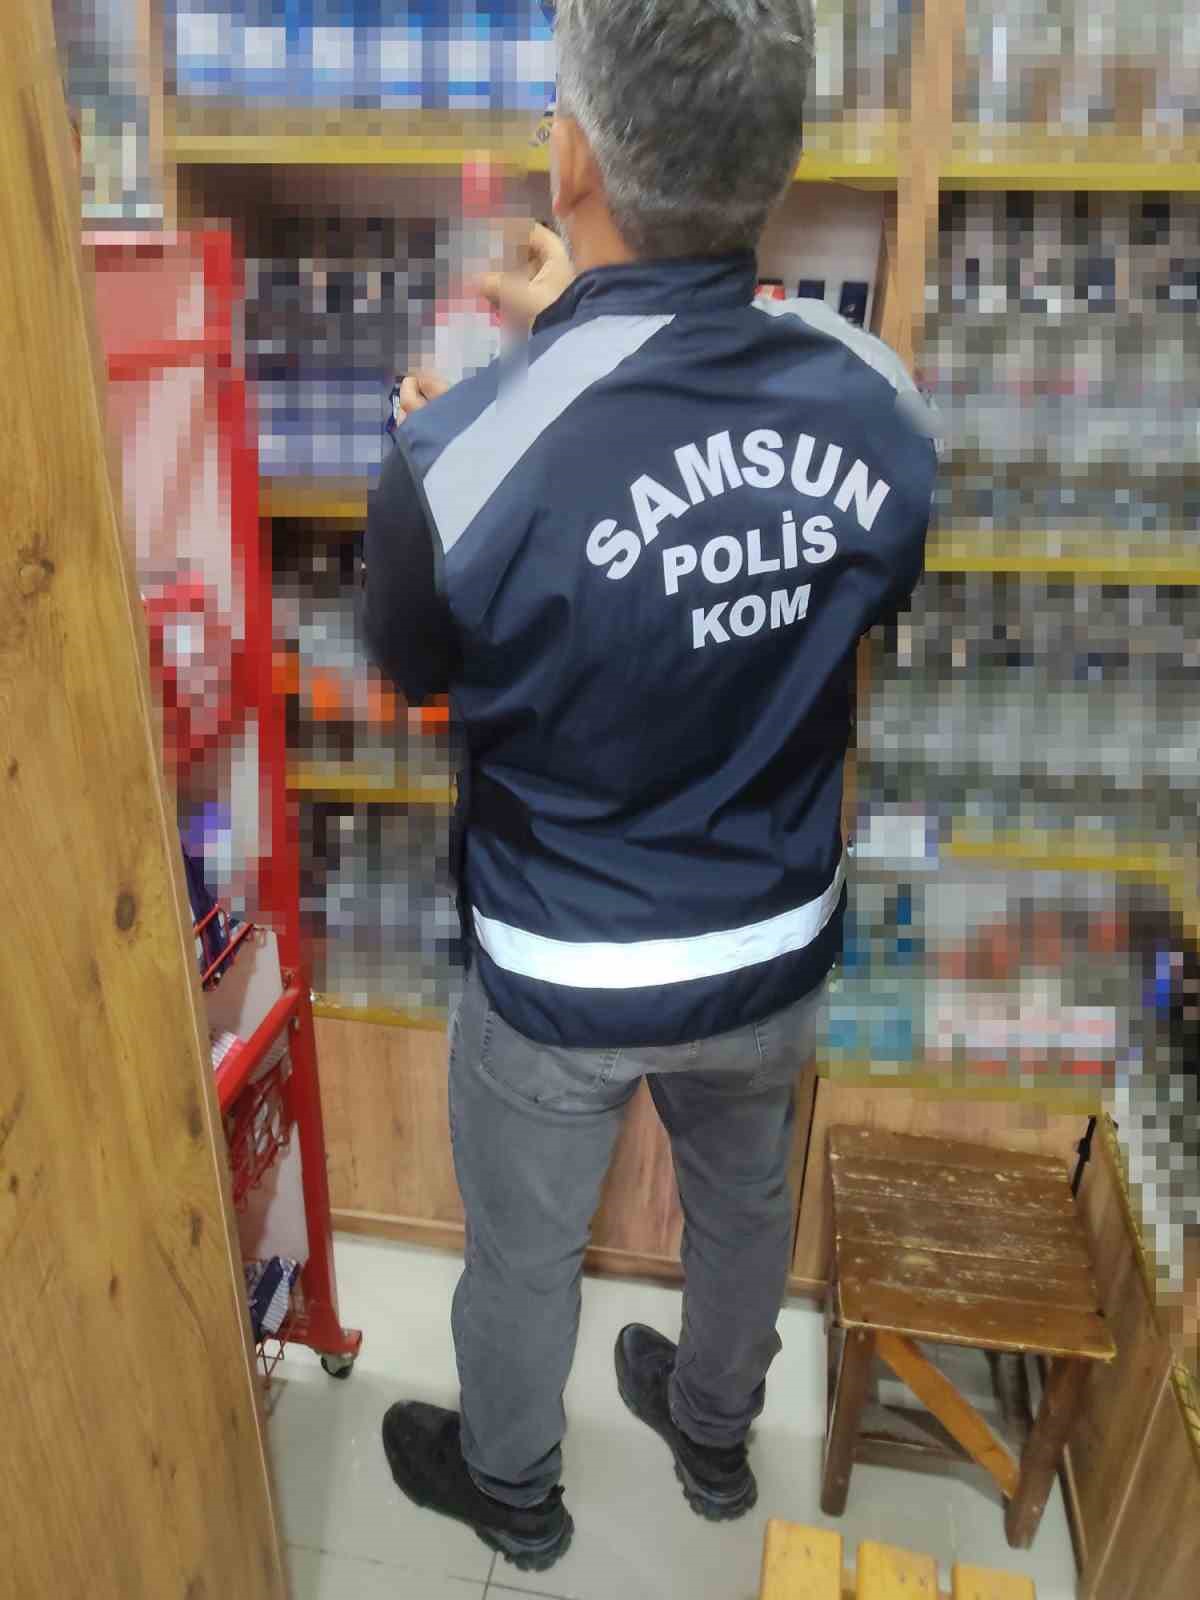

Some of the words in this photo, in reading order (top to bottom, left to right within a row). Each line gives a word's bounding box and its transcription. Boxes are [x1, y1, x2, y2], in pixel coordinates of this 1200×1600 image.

[586, 429, 890, 579] SAMSUN
[662, 510, 837, 595] POLİS
[692, 584, 811, 649] KOM
